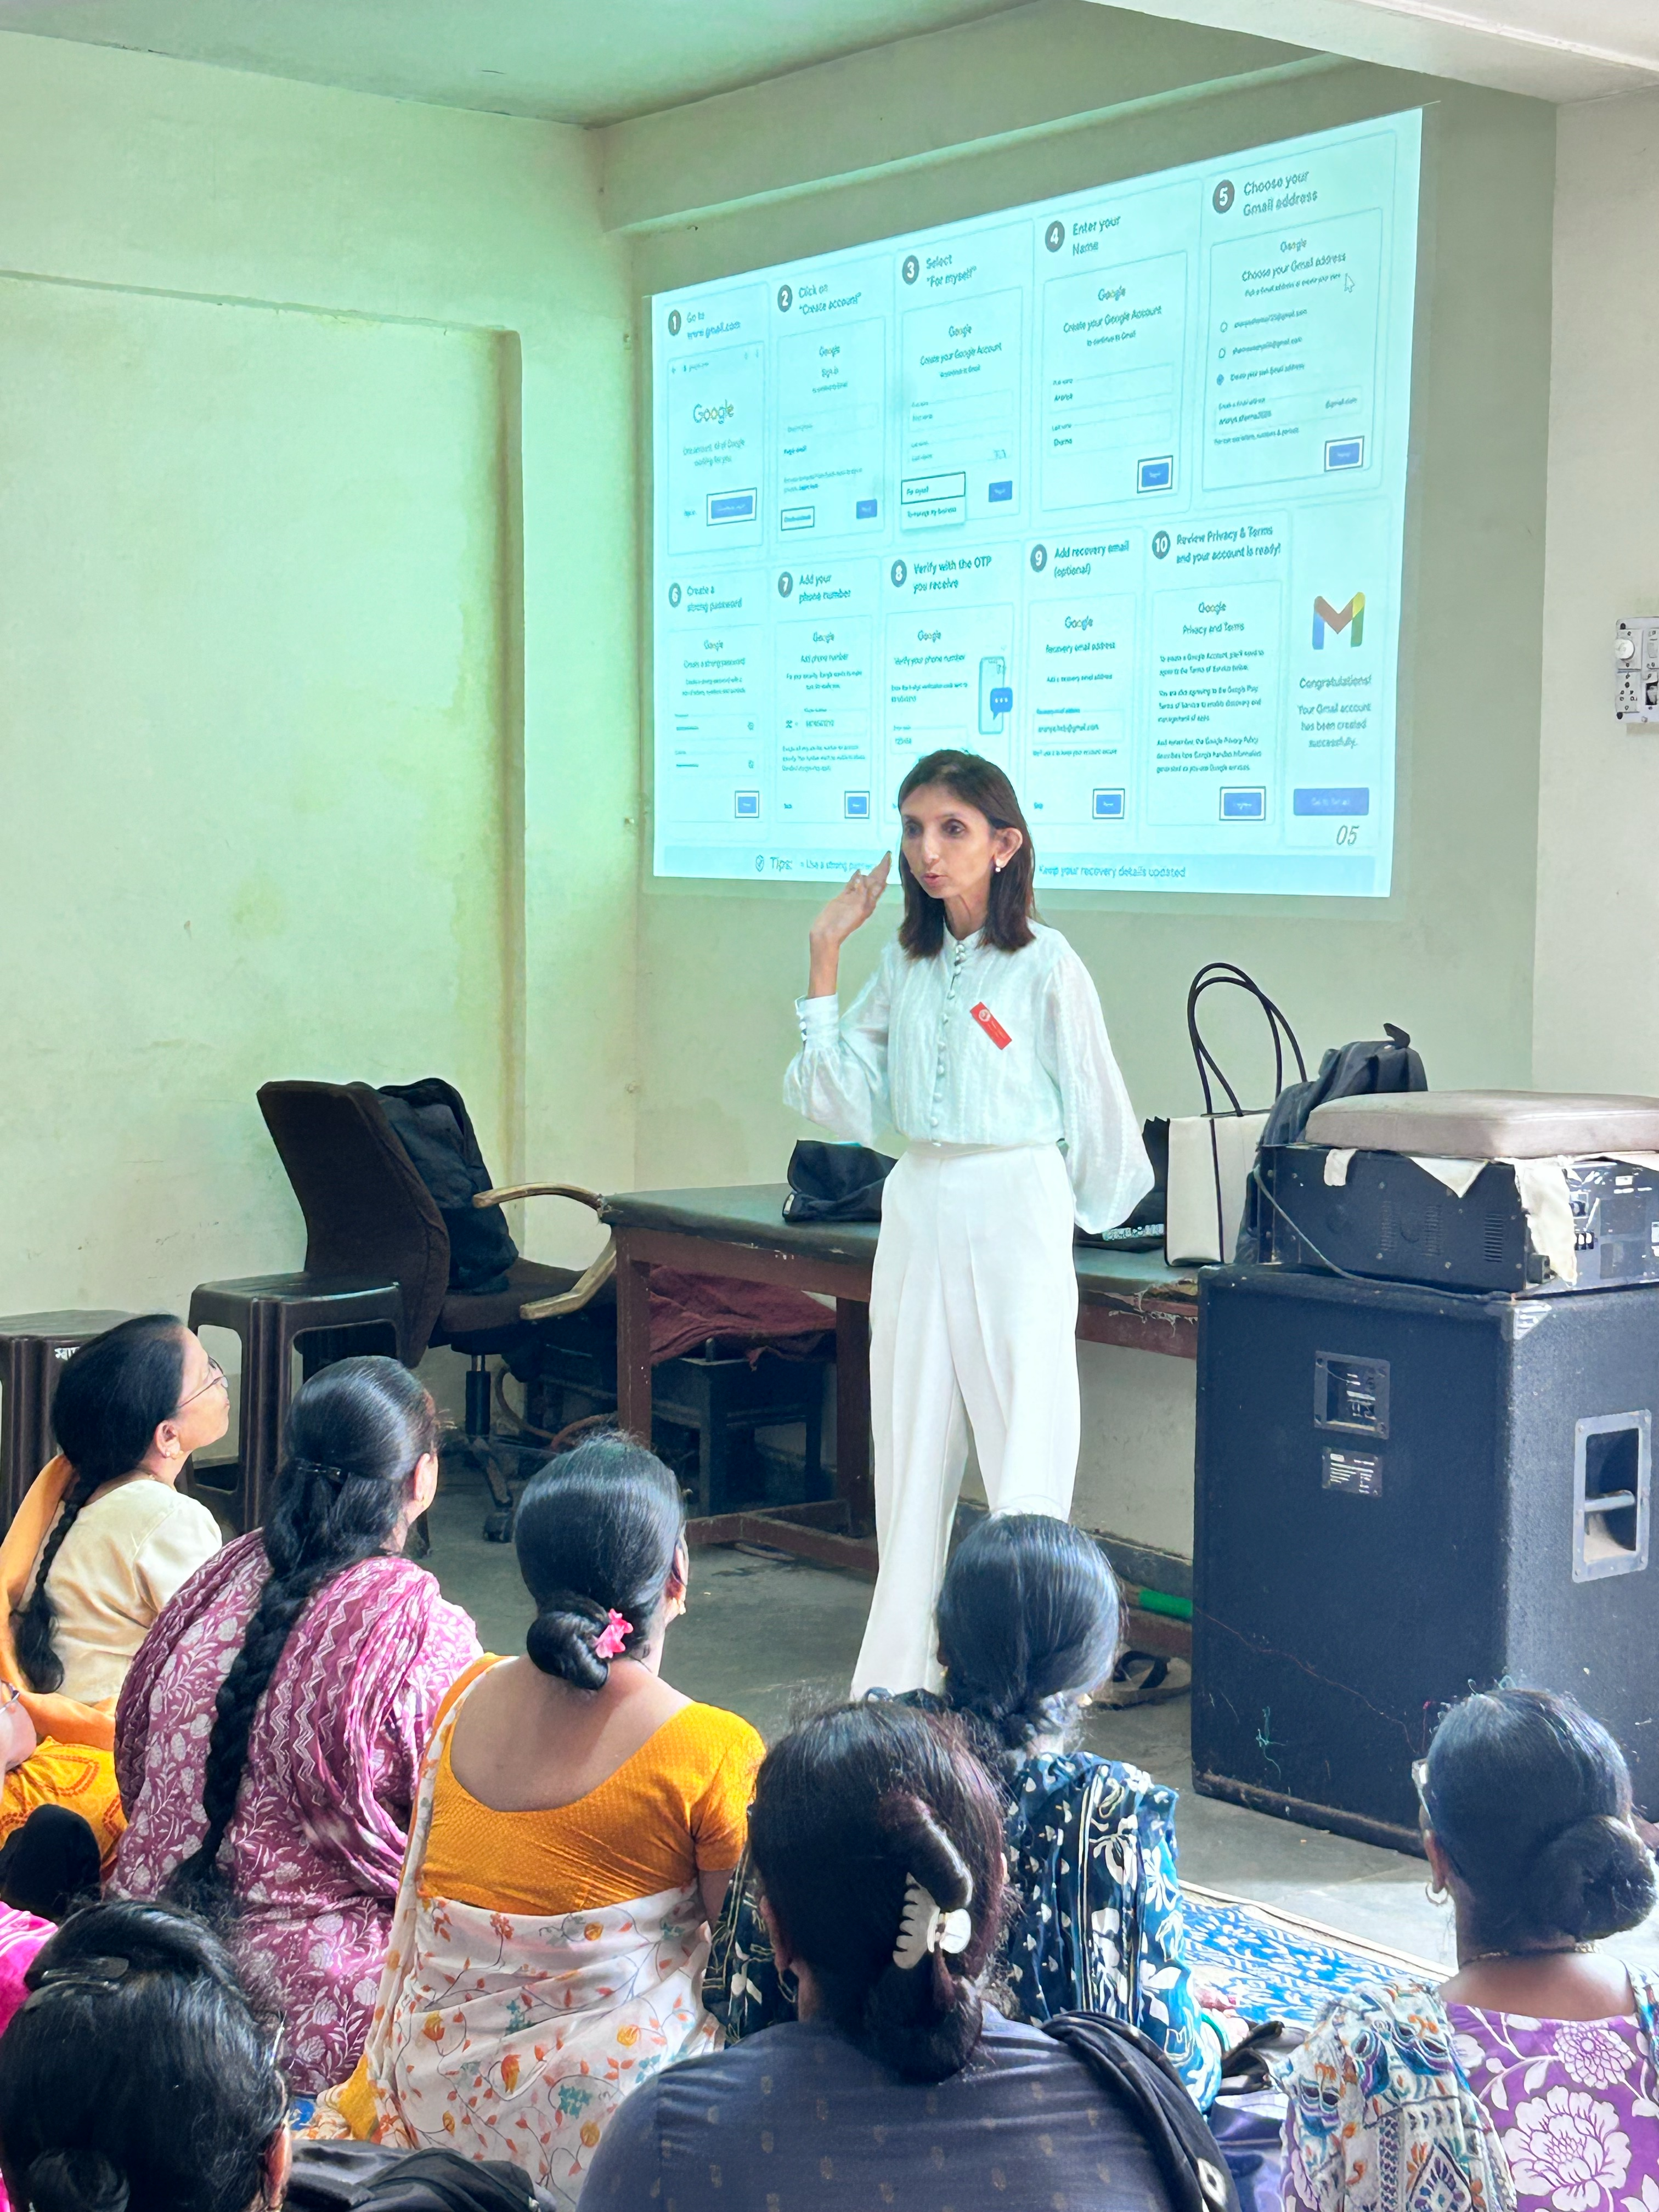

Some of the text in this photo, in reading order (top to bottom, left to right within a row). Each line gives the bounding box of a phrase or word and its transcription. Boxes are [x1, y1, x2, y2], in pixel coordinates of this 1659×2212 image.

[1243, 171, 1310, 196] Choose your
[1243, 190, 1318, 217] Gmail address
[1073, 216, 1121, 236] Enter your
[1073, 241, 1099, 256] Name
[926, 254, 952, 269] Select
[693, 399, 735, 424] Google
[1207, 529, 1238, 543] Privacy
[1248, 526, 1274, 538] Terms
[1054, 546, 1070, 559] Add
[1071, 545, 1106, 557] recovery
[1193, 552, 1210, 566] your
[1211, 547, 1245, 561] account
[913, 555, 992, 575] Verify with the OTP
[799, 574, 832, 587] Add your
[913, 577, 959, 595] you receive
[1183, 624, 1207, 637] Privacy
[1336, 824, 1360, 847] 05
[1081, 866, 1116, 878] recovery
